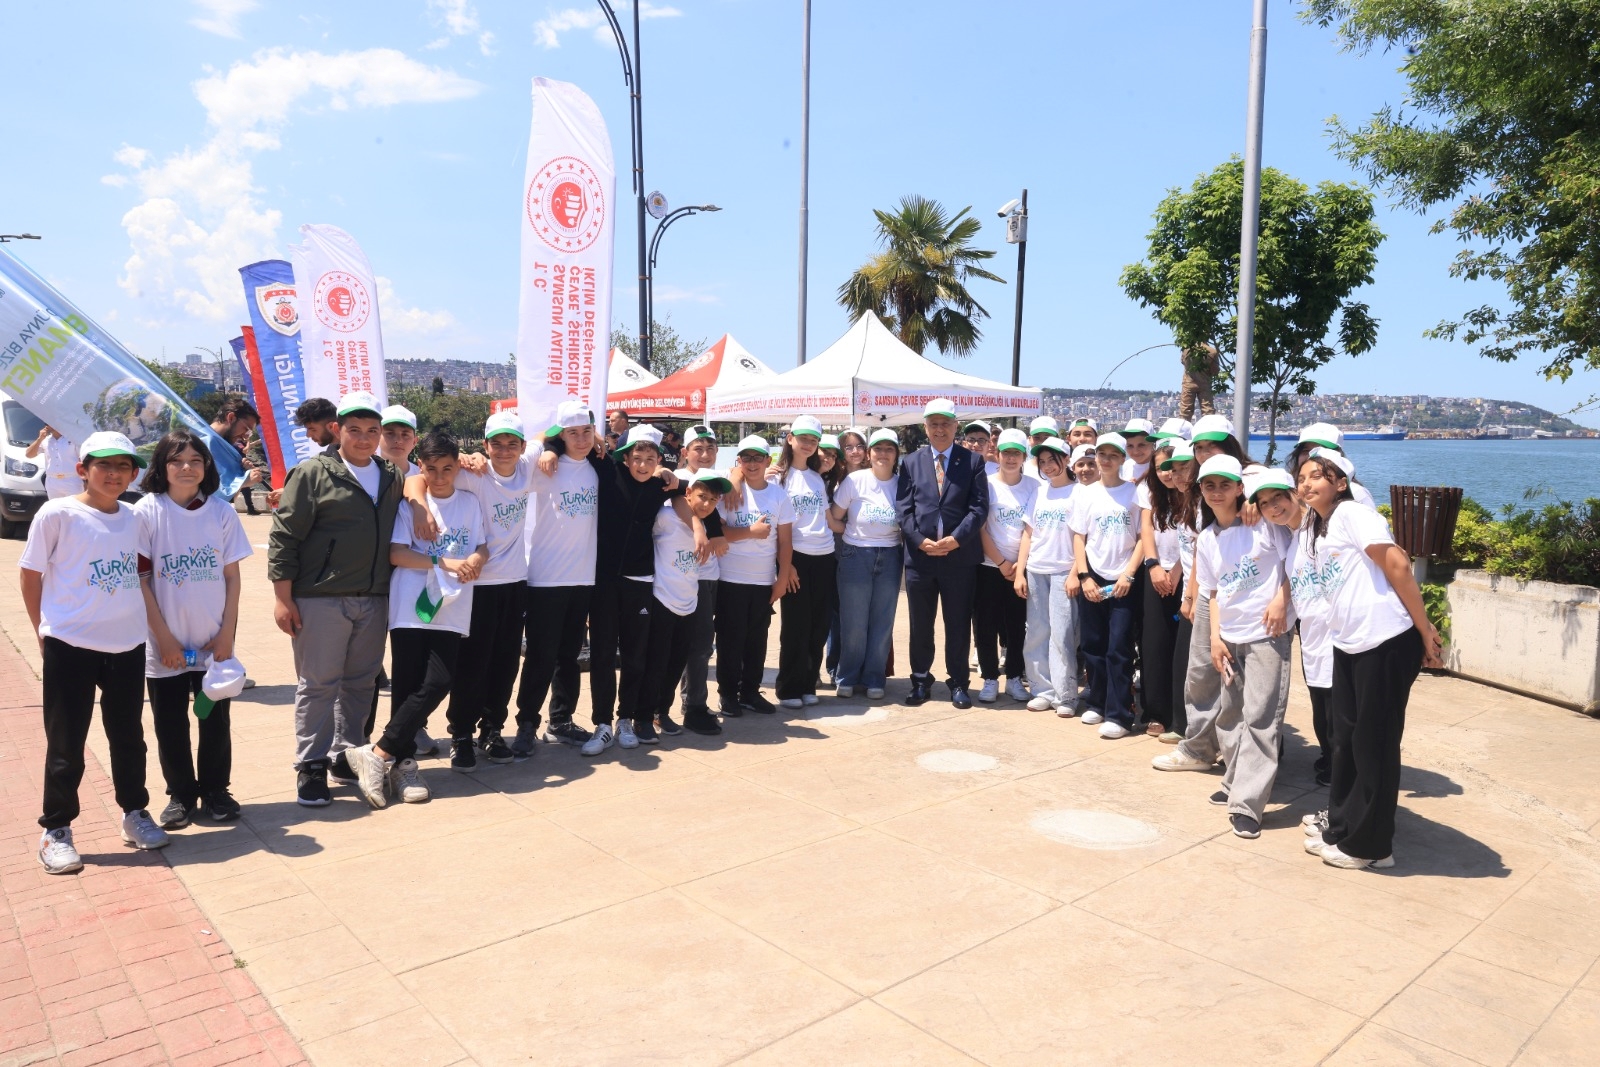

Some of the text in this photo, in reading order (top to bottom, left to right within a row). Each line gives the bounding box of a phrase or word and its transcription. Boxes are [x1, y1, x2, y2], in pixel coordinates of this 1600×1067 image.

[874, 395, 899, 406] SAMSUN
[900, 395, 919, 409] ÇEVRE
[160, 551, 218, 572] TÜRKİYE
